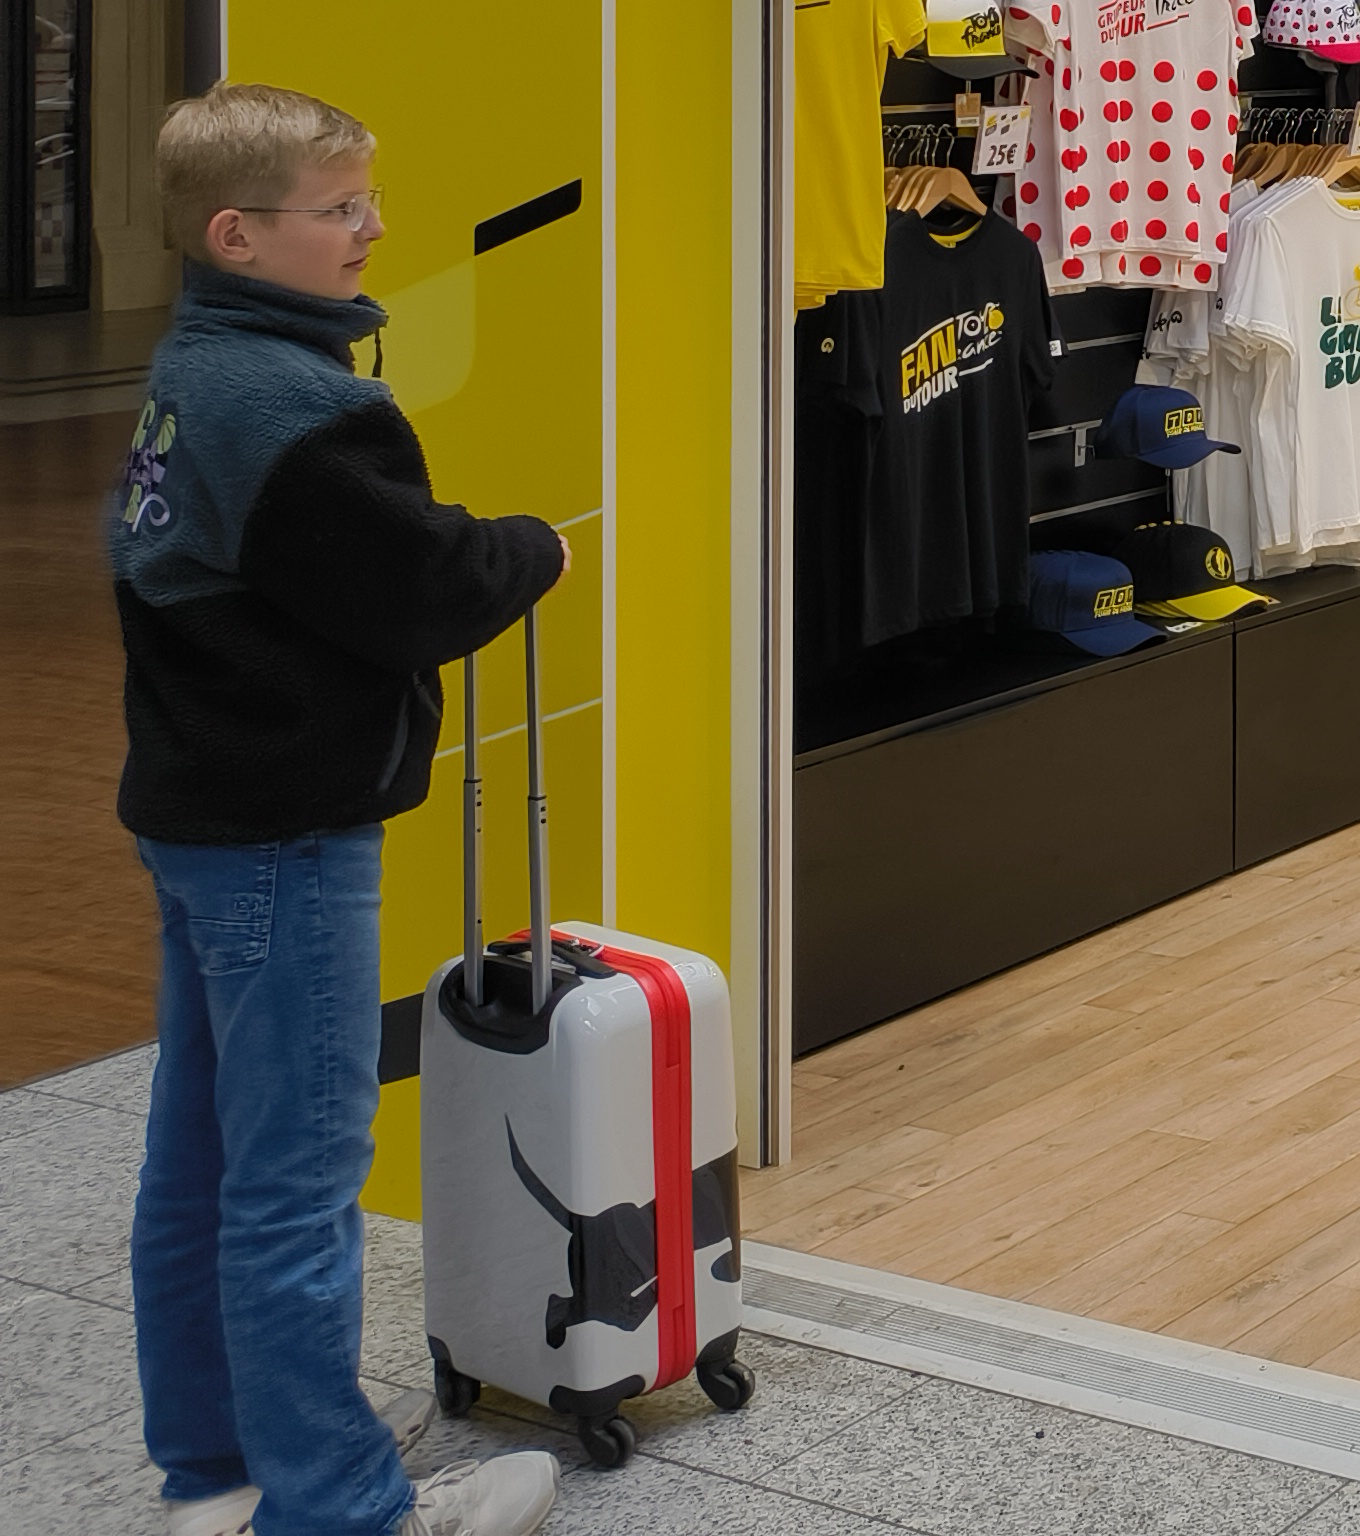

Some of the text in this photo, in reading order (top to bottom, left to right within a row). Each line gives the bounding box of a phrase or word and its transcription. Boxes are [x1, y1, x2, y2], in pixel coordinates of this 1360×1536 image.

[986, 142, 1017, 167] 25€
[901, 324, 957, 398] FAN
[903, 366, 958, 414] DU TOUR
